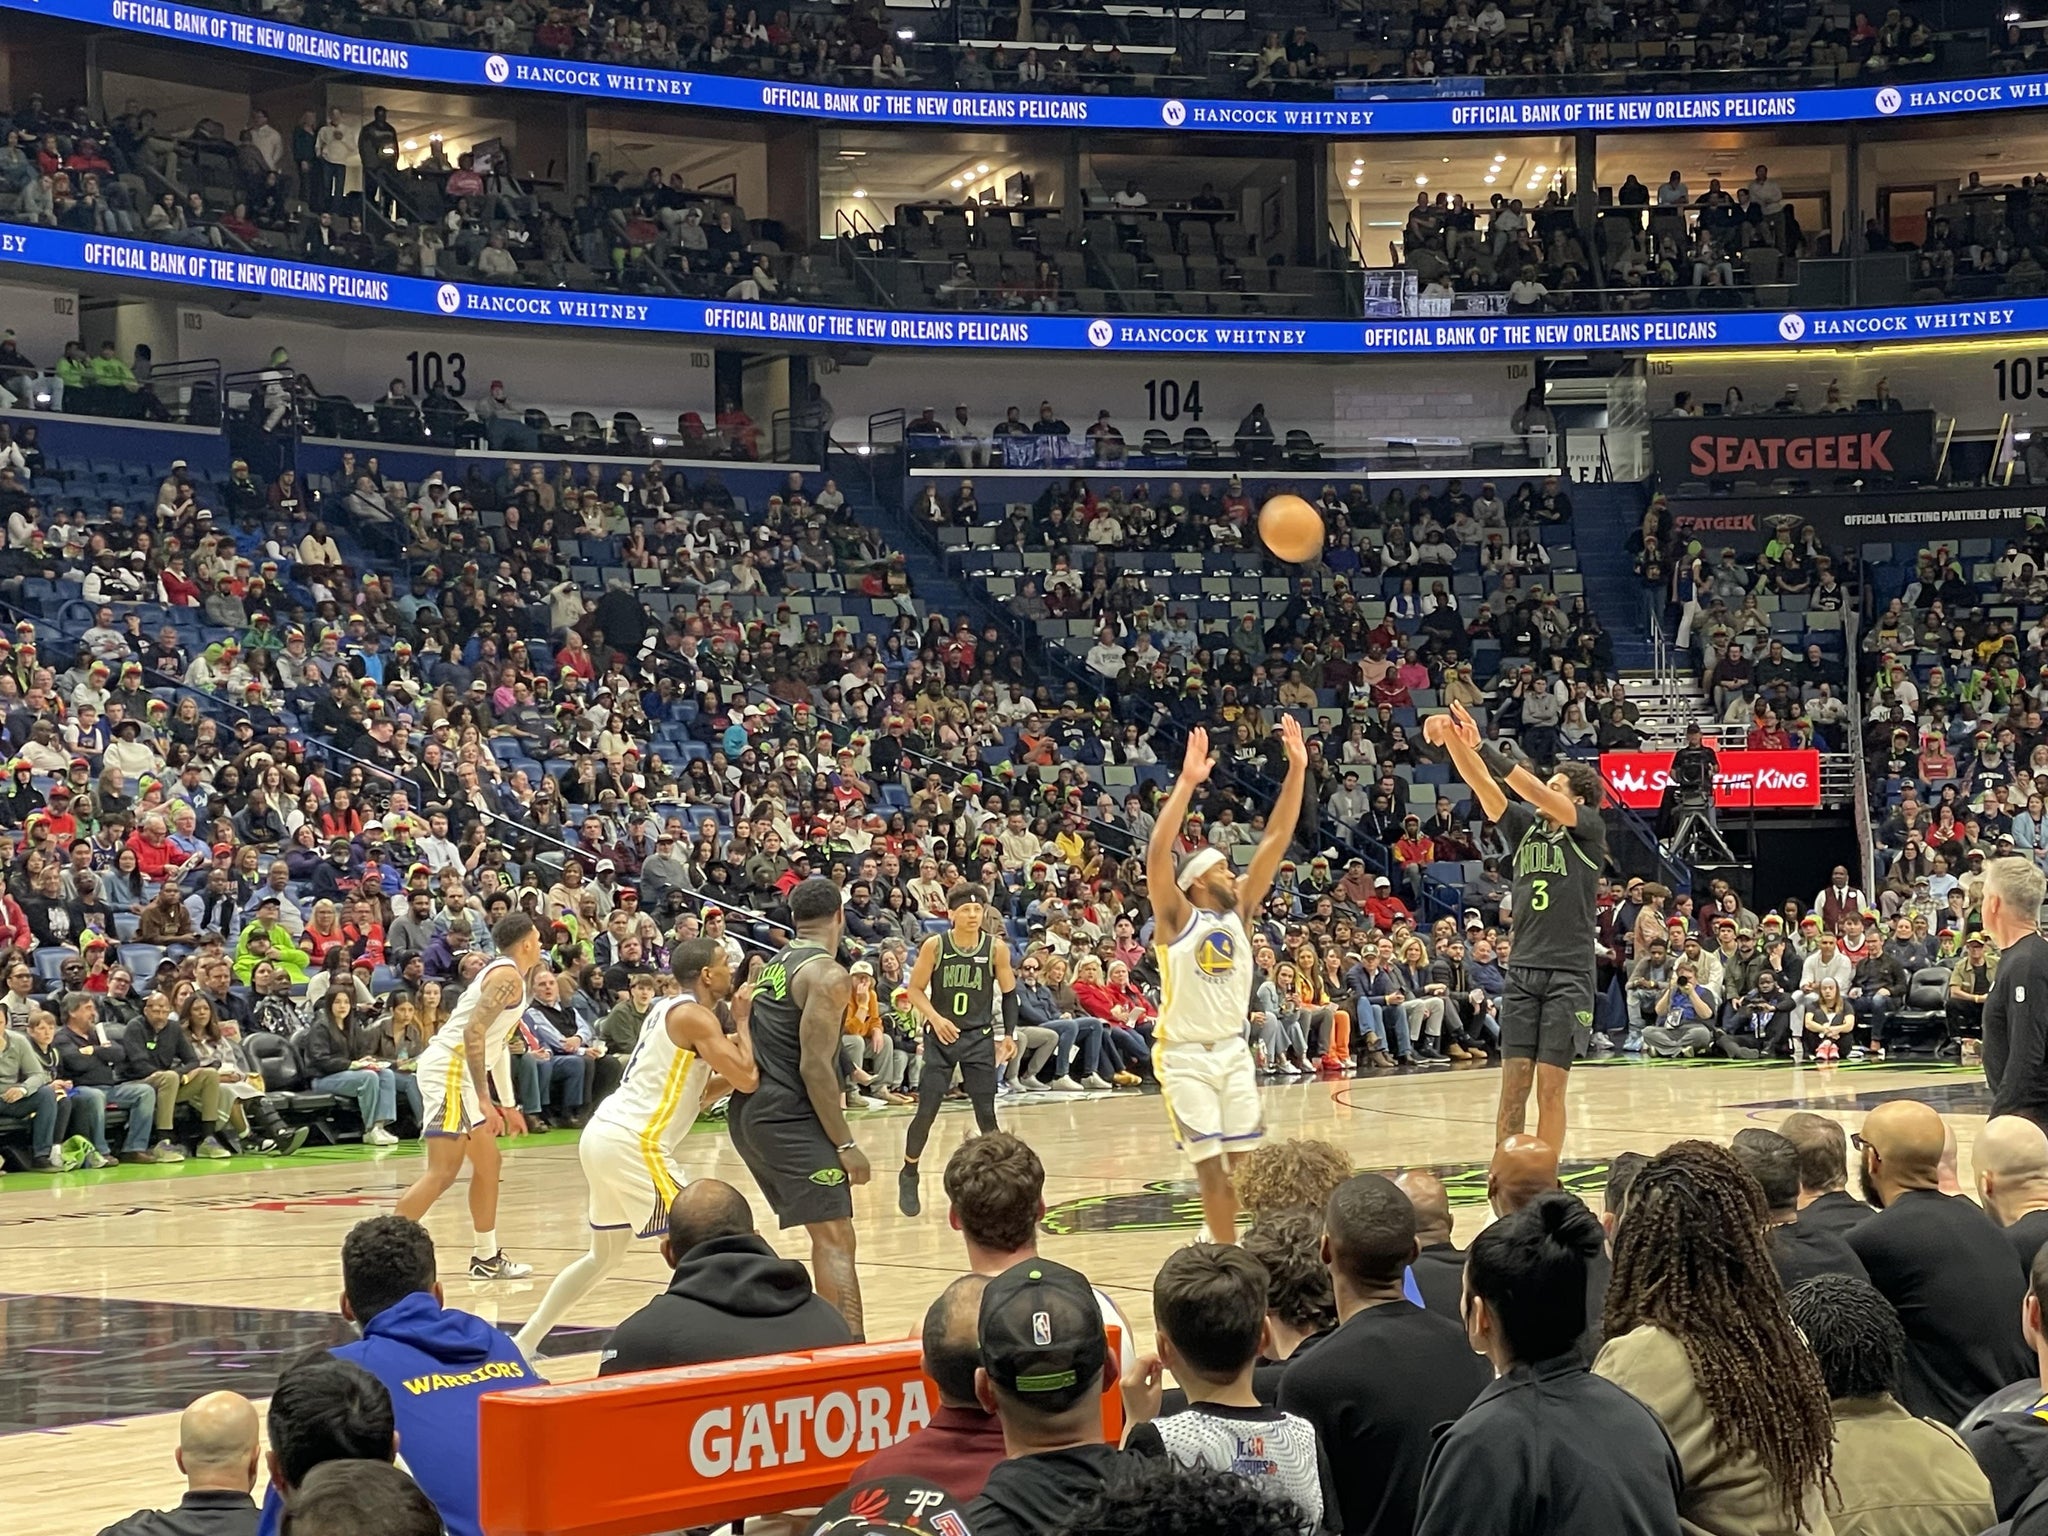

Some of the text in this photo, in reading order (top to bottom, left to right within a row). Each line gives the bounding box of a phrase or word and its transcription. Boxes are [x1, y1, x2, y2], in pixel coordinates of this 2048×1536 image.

[113, 0, 408, 69] OFFICIAL BANK OF THE NEW ORLEANS PELICANS
[517, 66, 691, 95] HANCOCK WHITNEY
[763, 87, 1088, 119] OFFICIAL BANK OF THE NEW ORLEANS PELICANS
[1911, 87, 2002, 106] HANCOCK
[1194, 108, 1374, 125] HANCOCK WHITNEY
[1452, 98, 1796, 124] OFFICIAL BANK OF THE NEW ORLEANS PELICANS
[85, 243, 389, 301] OFFICIAL BANK OF THE NEW ORLEANS PELICANS
[54, 297, 73, 316] 102
[467, 295, 648, 320] HANCOCK WHITNEY
[184, 312, 202, 330] 103
[704, 308, 1029, 342] OFFICIAL BANK OF THE NEW ORLEANS PELICANS
[1364, 321, 1717, 347] OFFICIAL BANK OF THE NEW ORLEANS PELICANS
[1813, 309, 2014, 335] HANCOCK WHITNEY
[1121, 327, 1306, 344] HANCOCK WHITNEY
[690, 352, 710, 368] 103
[1507, 364, 1528, 380] 104
[1650, 361, 1673, 375] 105
[406, 351, 466, 397] 103
[1144, 379, 1204, 422] 104
[1690, 429, 1894, 476] SEATGEEK
[1844, 512, 1887, 526] OFFICIAL
[1888, 510, 1940, 524] TICKETING
[1941, 509, 1987, 522] PARTNER
[1988, 508, 2001, 520] OF
[2002, 507, 2022, 519] THE
[1520, 842, 1568, 877] NOLA
[1531, 880, 1549, 911] 3
[943, 964, 983, 990] NOLA
[953, 992, 968, 1016] 0
[402, 1362, 524, 1395] WARRIORS
[689, 1380, 931, 1478] GATORA
